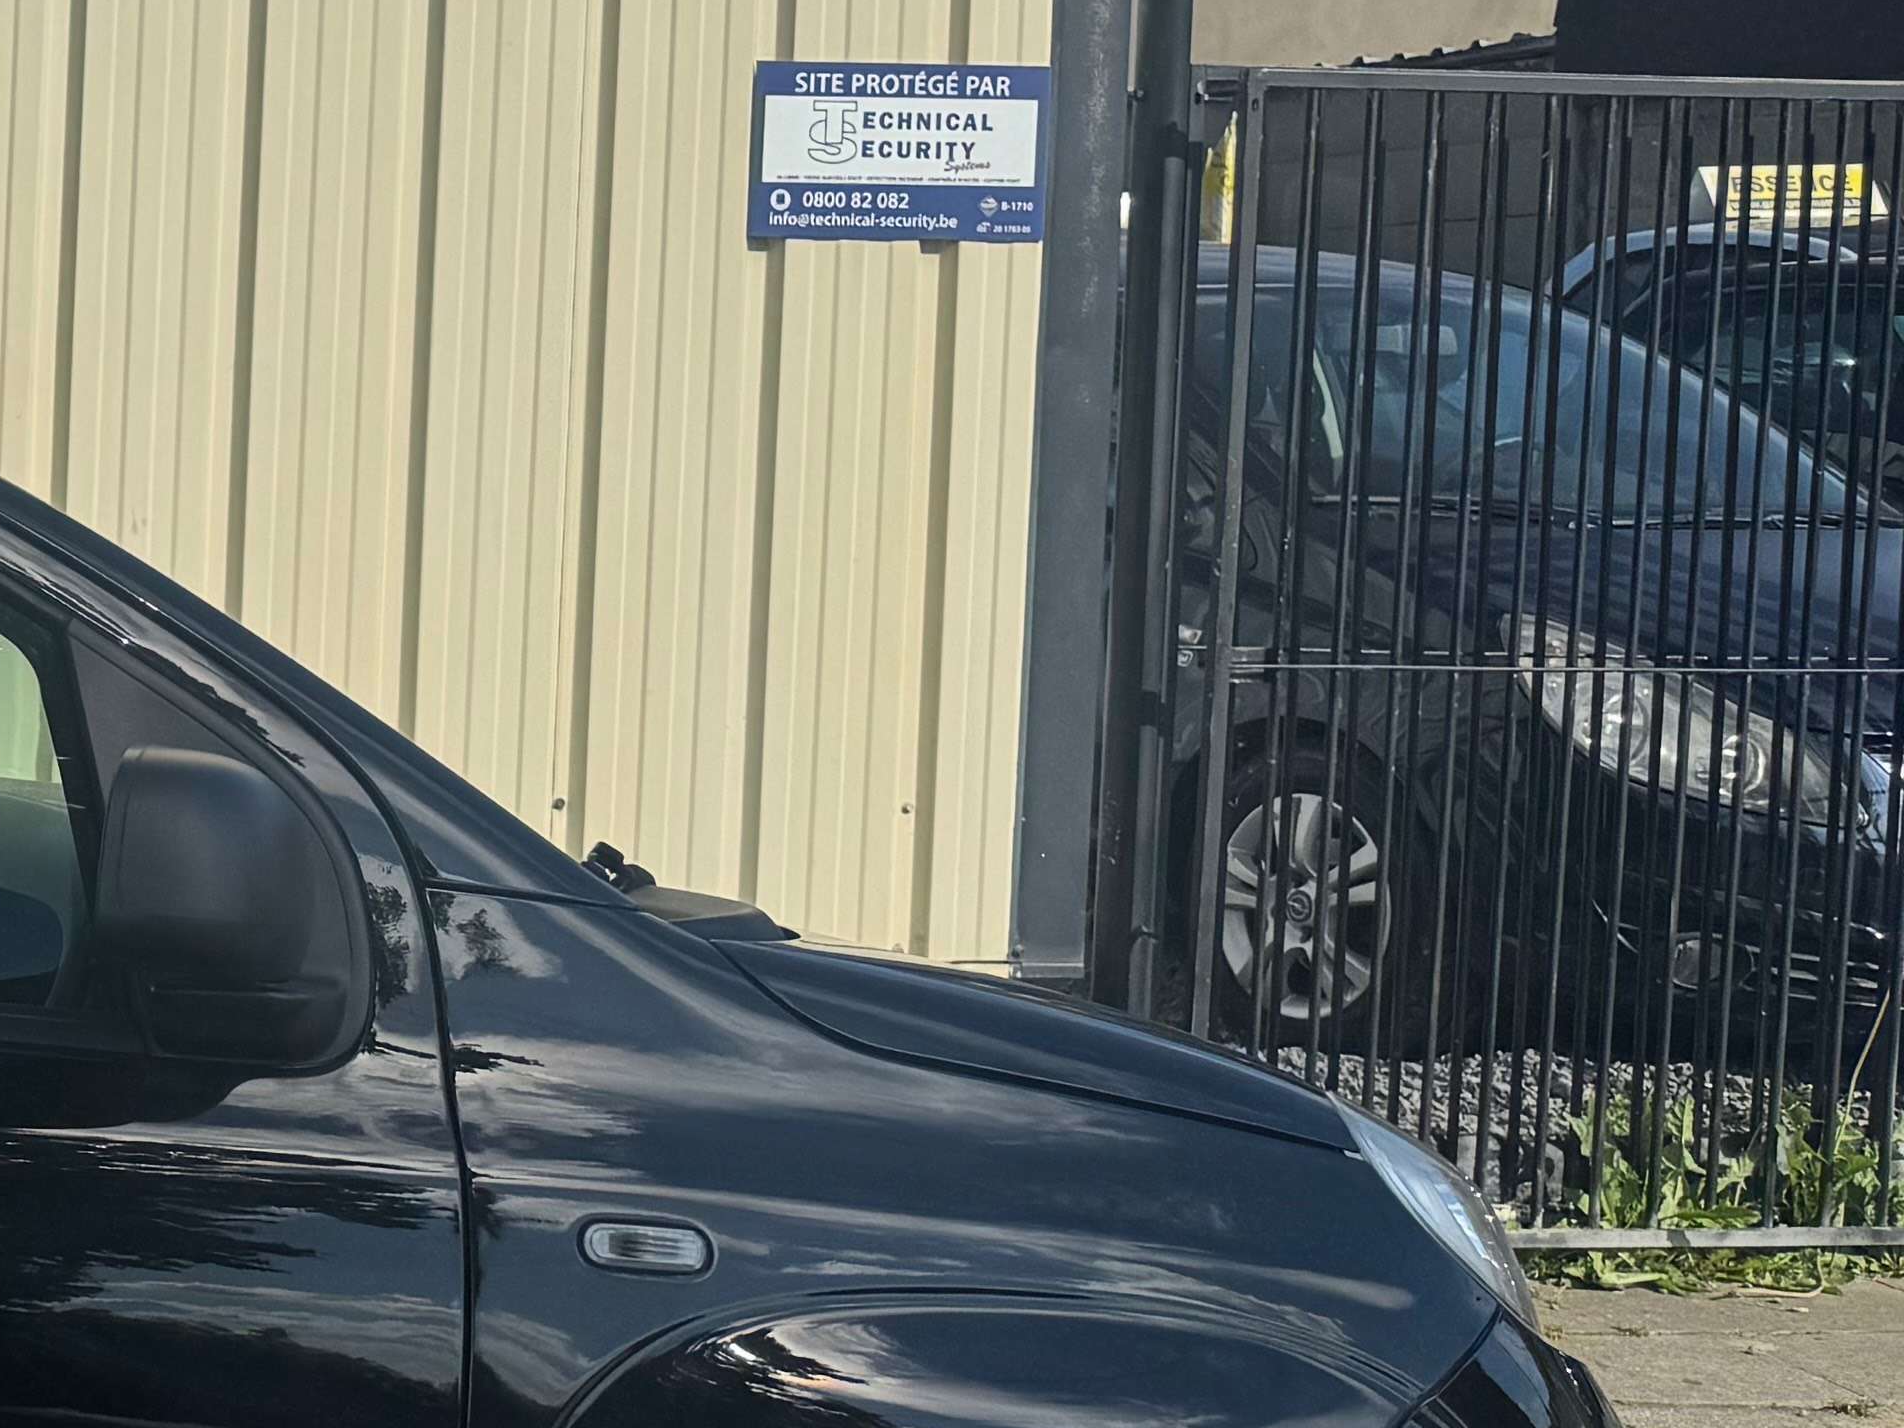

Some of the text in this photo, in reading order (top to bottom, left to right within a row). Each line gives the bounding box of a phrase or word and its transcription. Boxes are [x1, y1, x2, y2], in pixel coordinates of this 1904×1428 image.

[795, 71, 1010, 96] SITE PROTÉGÉ PAR
[1731, 175, 1854, 193] ESSECE
[803, 191, 909, 209] 0800 82 082
[769, 211, 958, 231] info@technical-security.be
